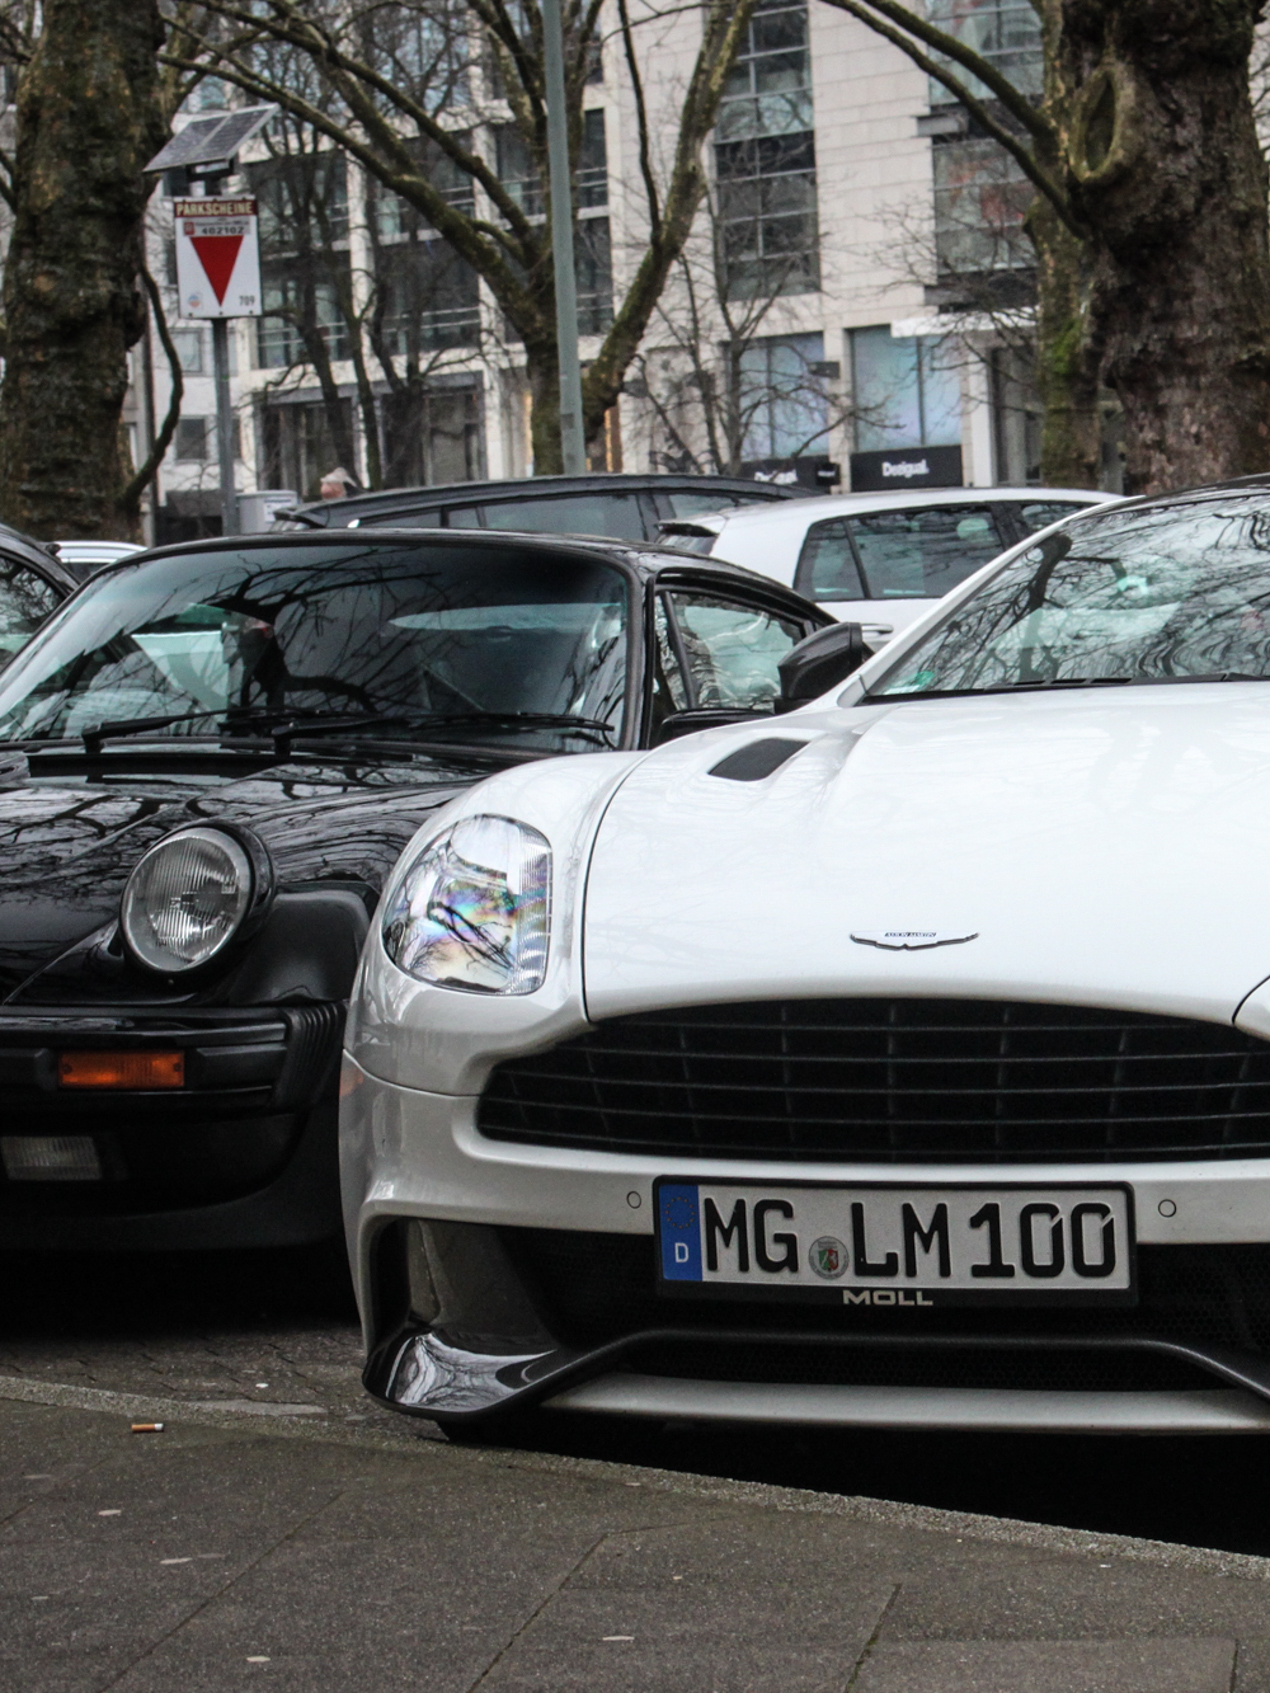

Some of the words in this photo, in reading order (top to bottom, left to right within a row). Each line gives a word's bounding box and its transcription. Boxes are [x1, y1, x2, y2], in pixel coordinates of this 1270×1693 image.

[176, 201, 253, 215] PARKSCHEINE
[239, 295, 255, 306] 709
[705, 1197, 799, 1273] MG
[851, 1202, 951, 1278] LM
[969, 1202, 1116, 1279] 100
[675, 1243, 689, 1263] D
[842, 1289, 934, 1306] MOLL
